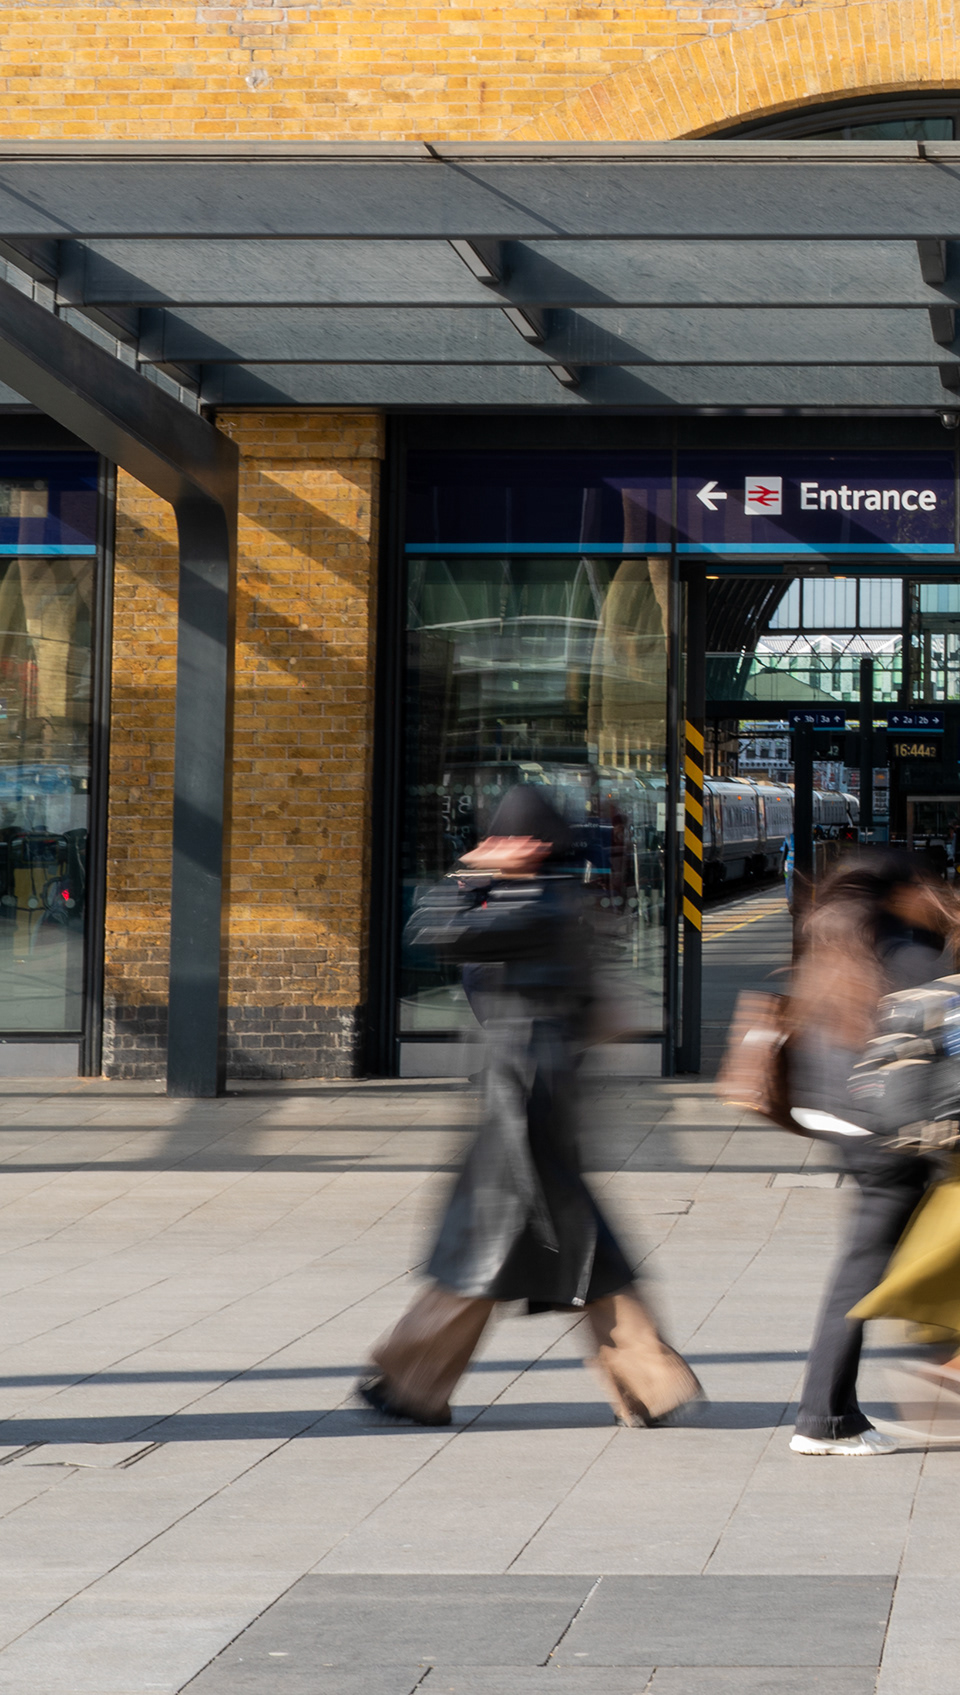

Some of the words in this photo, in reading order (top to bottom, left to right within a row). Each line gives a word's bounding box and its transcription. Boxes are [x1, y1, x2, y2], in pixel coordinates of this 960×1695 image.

[800, 482, 937, 511] Entrance
[804, 715, 815, 724] 3b
[820, 715, 831, 724] 3a
[902, 716, 913, 724] 2a
[918, 716, 929, 725] 2b
